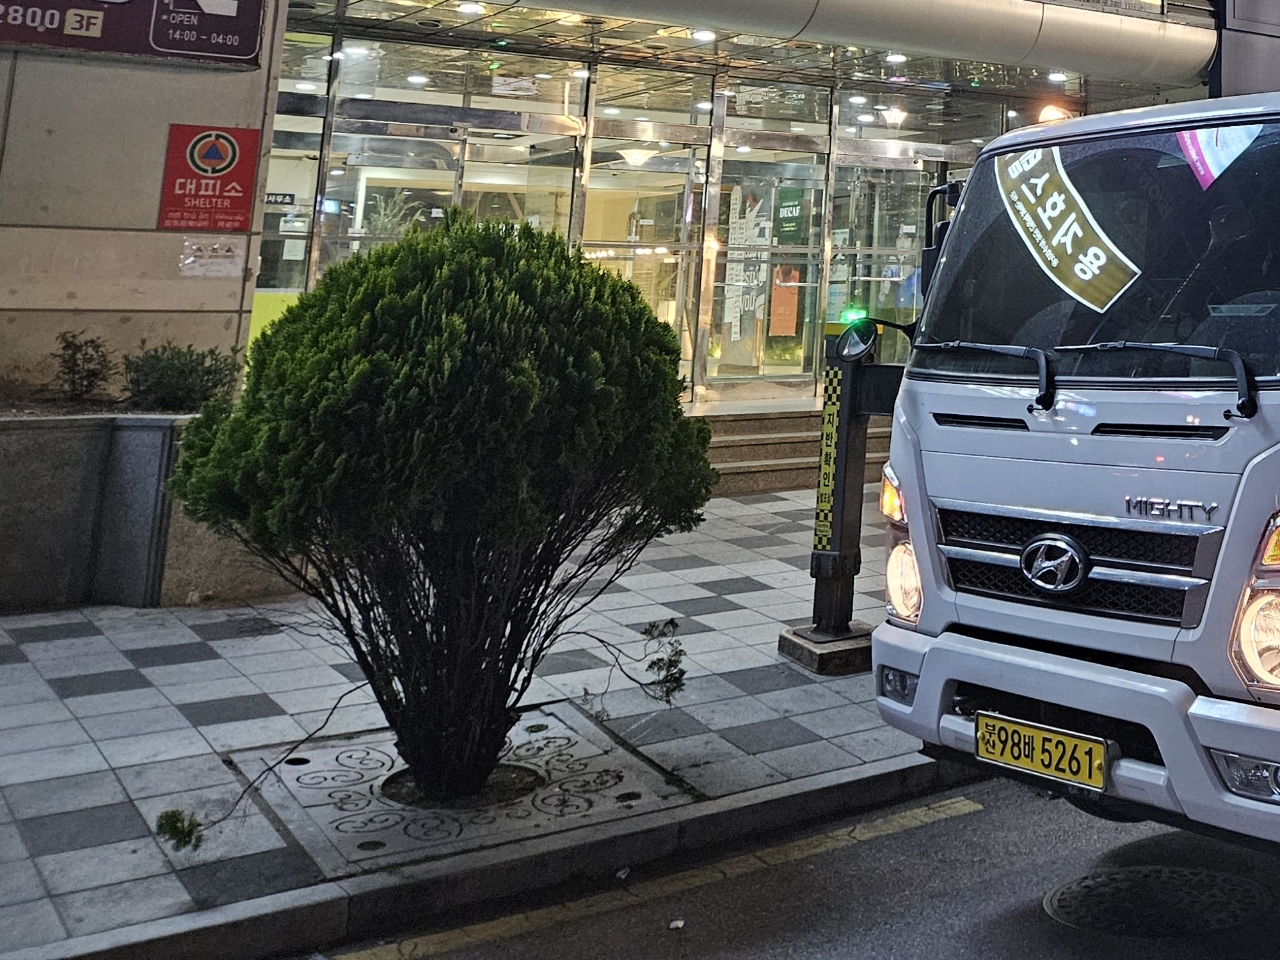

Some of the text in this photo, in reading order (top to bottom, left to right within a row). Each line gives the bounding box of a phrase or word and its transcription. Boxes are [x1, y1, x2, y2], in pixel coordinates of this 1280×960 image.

[0, 3, 100, 32] 800 3F
[169, 13, 198, 25] OPEN
[168, 28, 197, 40] 14:00
[211, 33, 239, 46] 04:00
[174, 178, 243, 197] 대피소
[184, 197, 231, 208] SHELTER
[265, 194, 292, 204] 사무소
[822, 412, 835, 488] 지반확인
[1124, 495, 1219, 522] MIGHTY
[984, 722, 1094, 780] 부산 98바 5261
